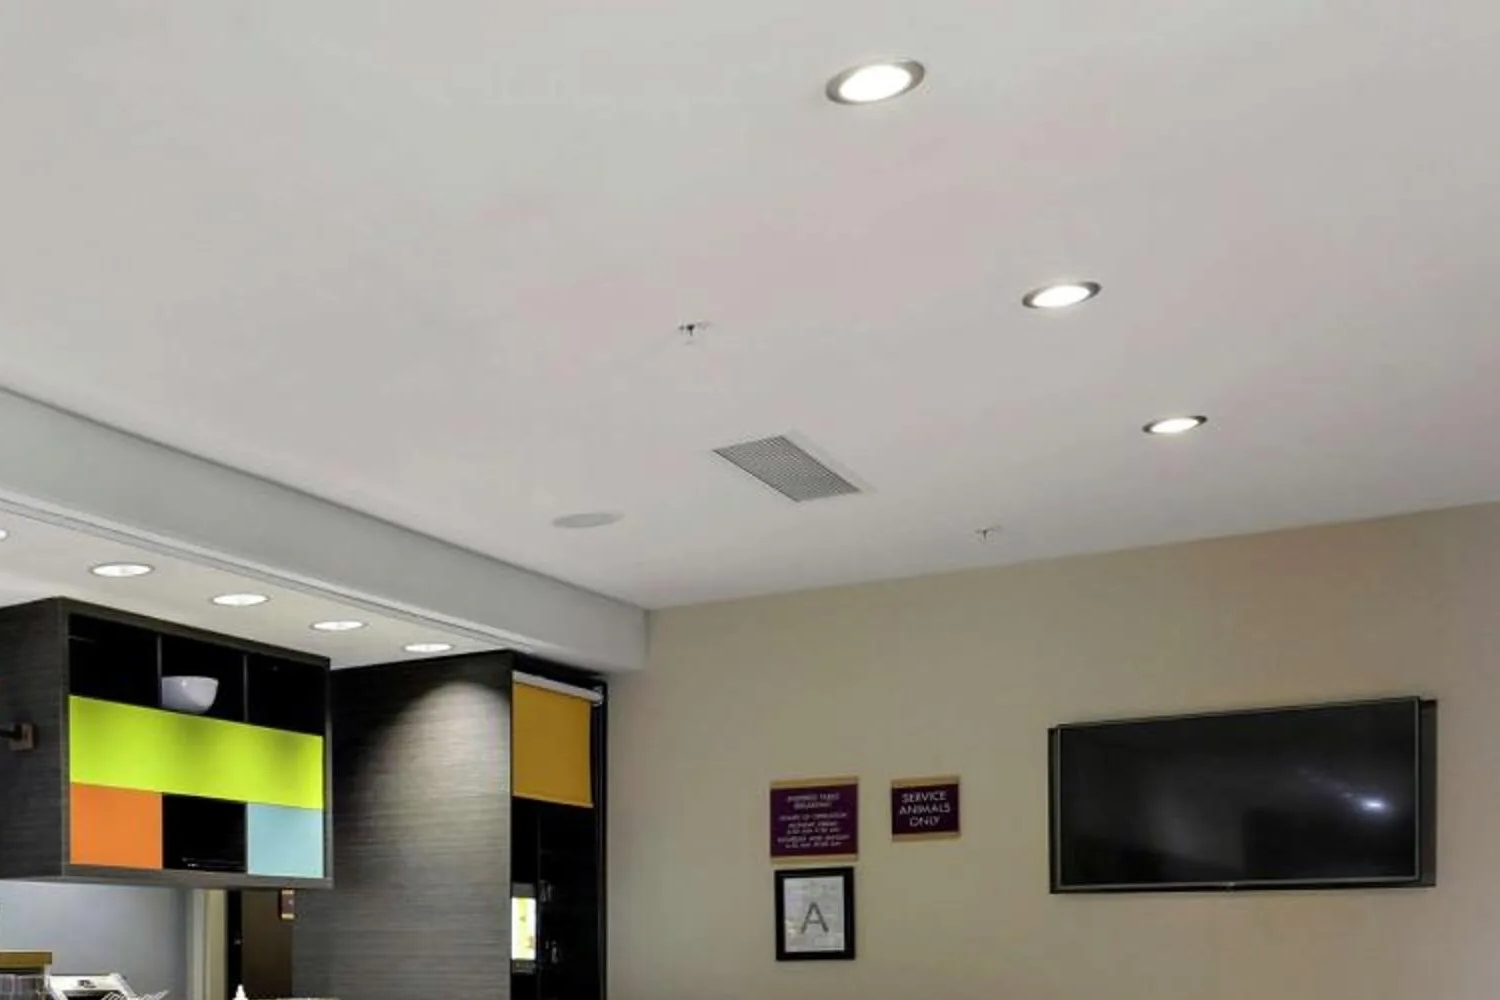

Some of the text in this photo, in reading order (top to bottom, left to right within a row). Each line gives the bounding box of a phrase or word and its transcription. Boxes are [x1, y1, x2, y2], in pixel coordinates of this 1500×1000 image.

[901, 790, 948, 803] SERVICE
[899, 802, 951, 815] ANIMALS
[909, 815, 941, 828] ONLY
[801, 901, 830, 934] A
